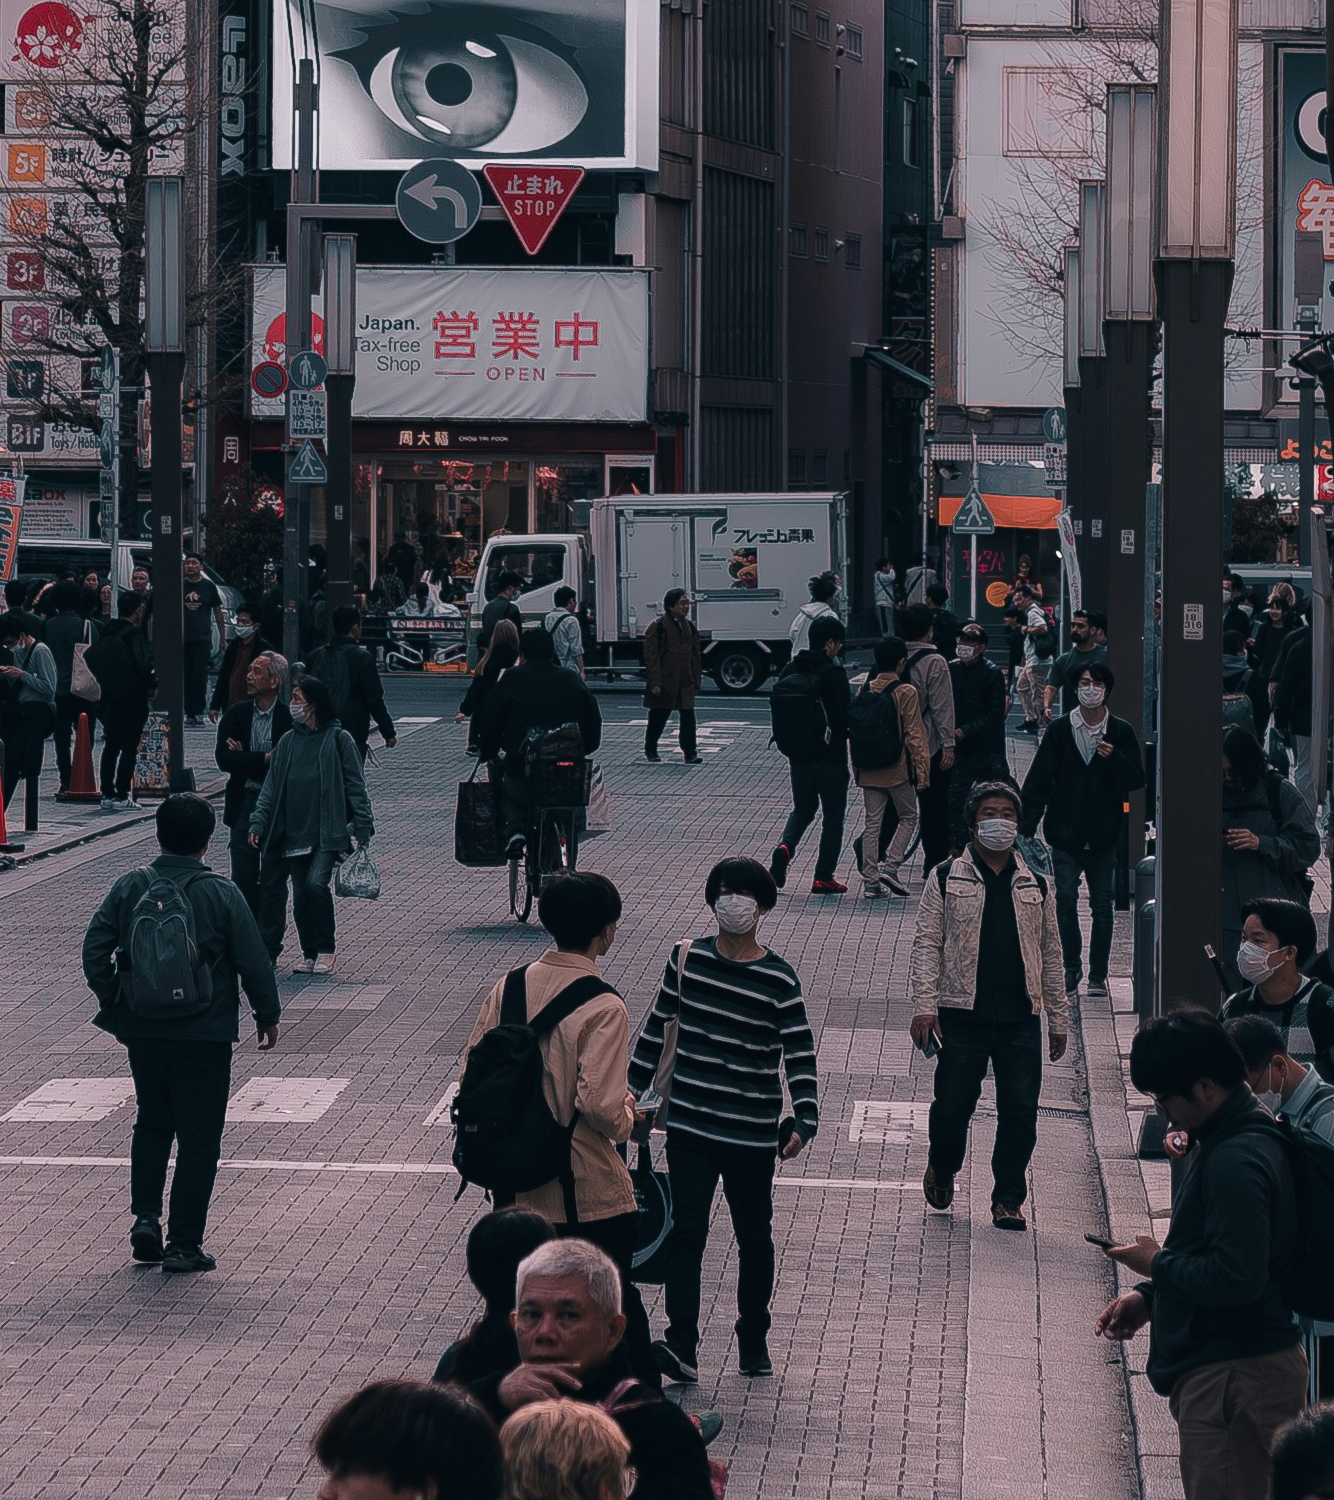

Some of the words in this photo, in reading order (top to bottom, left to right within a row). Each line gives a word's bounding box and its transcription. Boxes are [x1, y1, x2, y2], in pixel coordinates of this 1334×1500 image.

[503, 175, 564, 198] 止まれ
[513, 199, 556, 216] STOP
[359, 315, 420, 335] Japan.
[430, 310, 601, 363] 営業中
[376, 355, 421, 376] Shop
[487, 366, 545, 382] OPEN
[398, 430, 450, 447] 周大福
